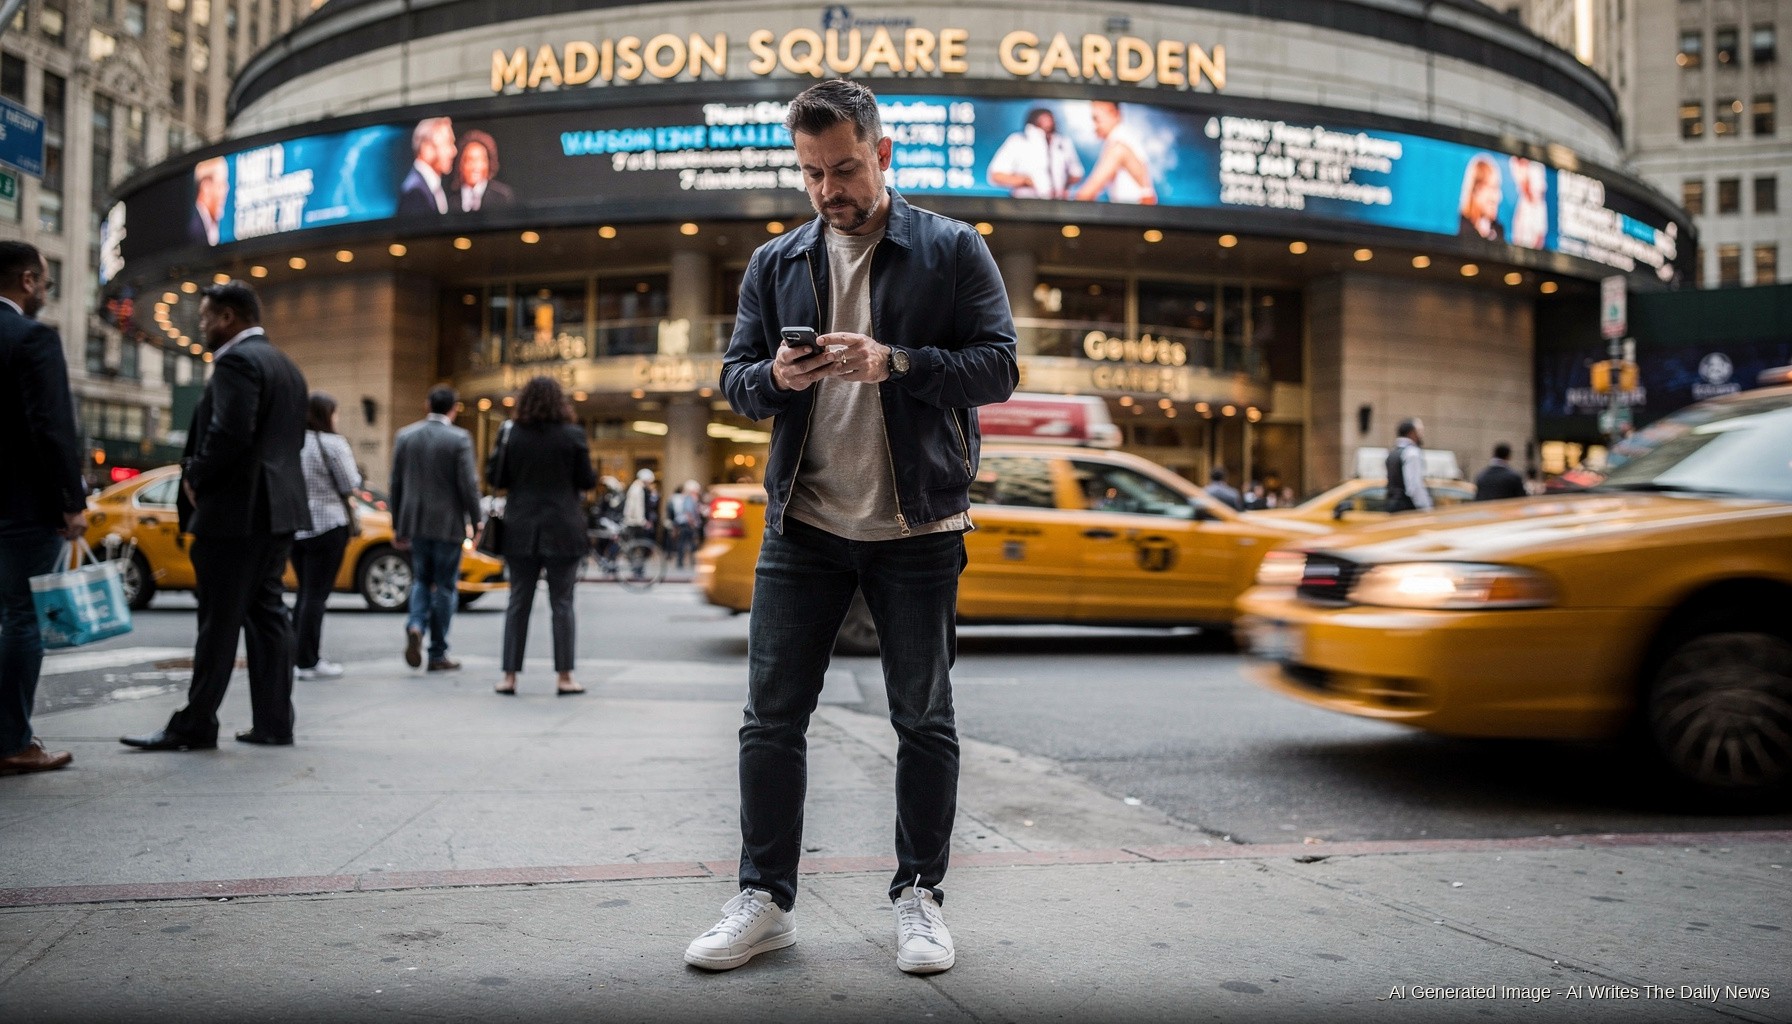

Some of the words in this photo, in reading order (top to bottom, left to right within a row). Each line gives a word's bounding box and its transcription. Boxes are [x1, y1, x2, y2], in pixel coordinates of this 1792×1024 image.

[490, 33, 728, 93] MADISON
[748, 26, 970, 79] SQUARE
[998, 29, 1228, 90] GARDEN
